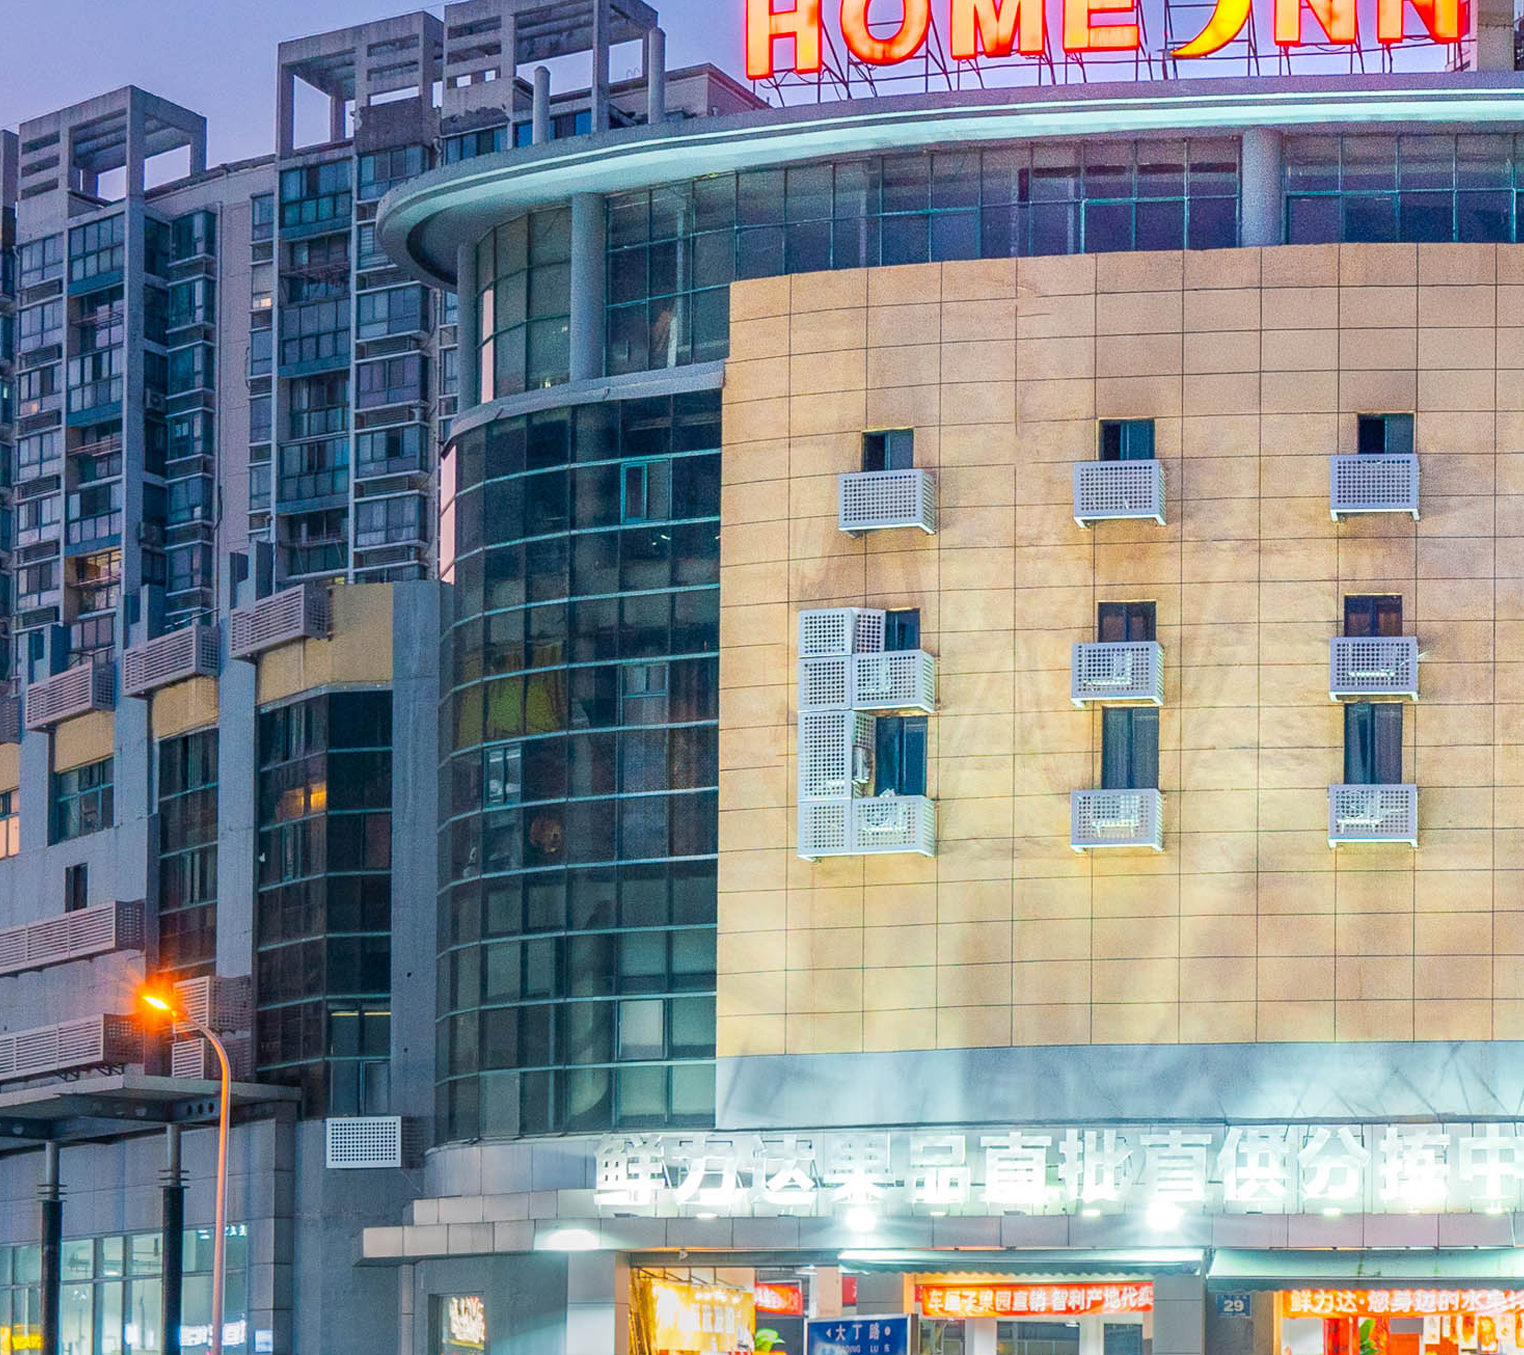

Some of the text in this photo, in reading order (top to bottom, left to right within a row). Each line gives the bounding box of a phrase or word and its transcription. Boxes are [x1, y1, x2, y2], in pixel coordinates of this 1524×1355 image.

[1223, 1299, 1244, 1312] 29
[835, 1323, 880, 1341] 大丁路
